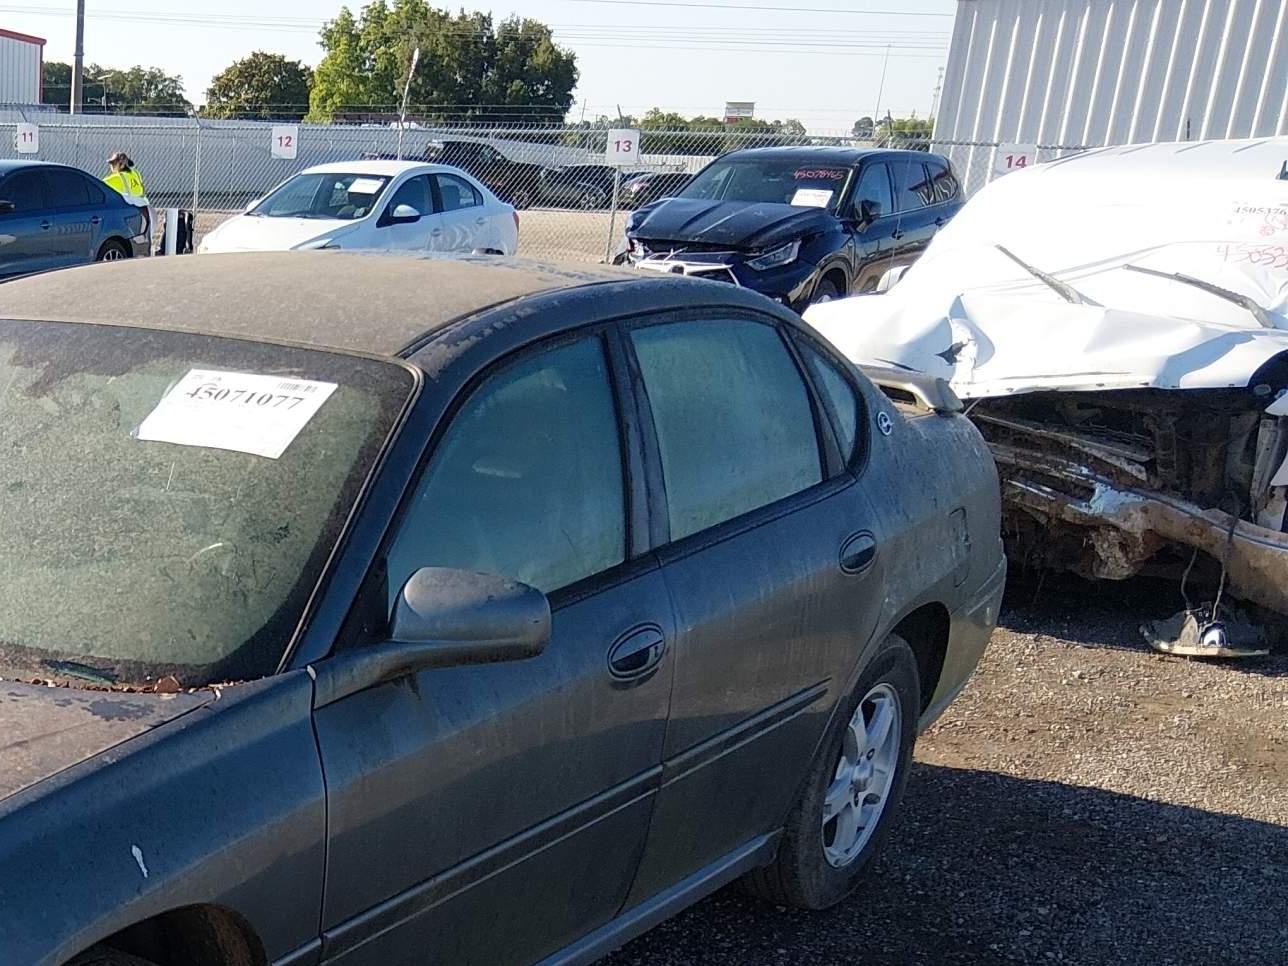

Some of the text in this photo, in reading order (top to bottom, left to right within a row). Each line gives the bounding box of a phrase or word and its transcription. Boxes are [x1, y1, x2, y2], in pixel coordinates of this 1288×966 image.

[21, 131, 33, 143] 11
[277, 135, 293, 148] 12
[614, 140, 633, 153] 13
[1005, 154, 1028, 169] 14
[185, 385, 305, 410] 45071077
